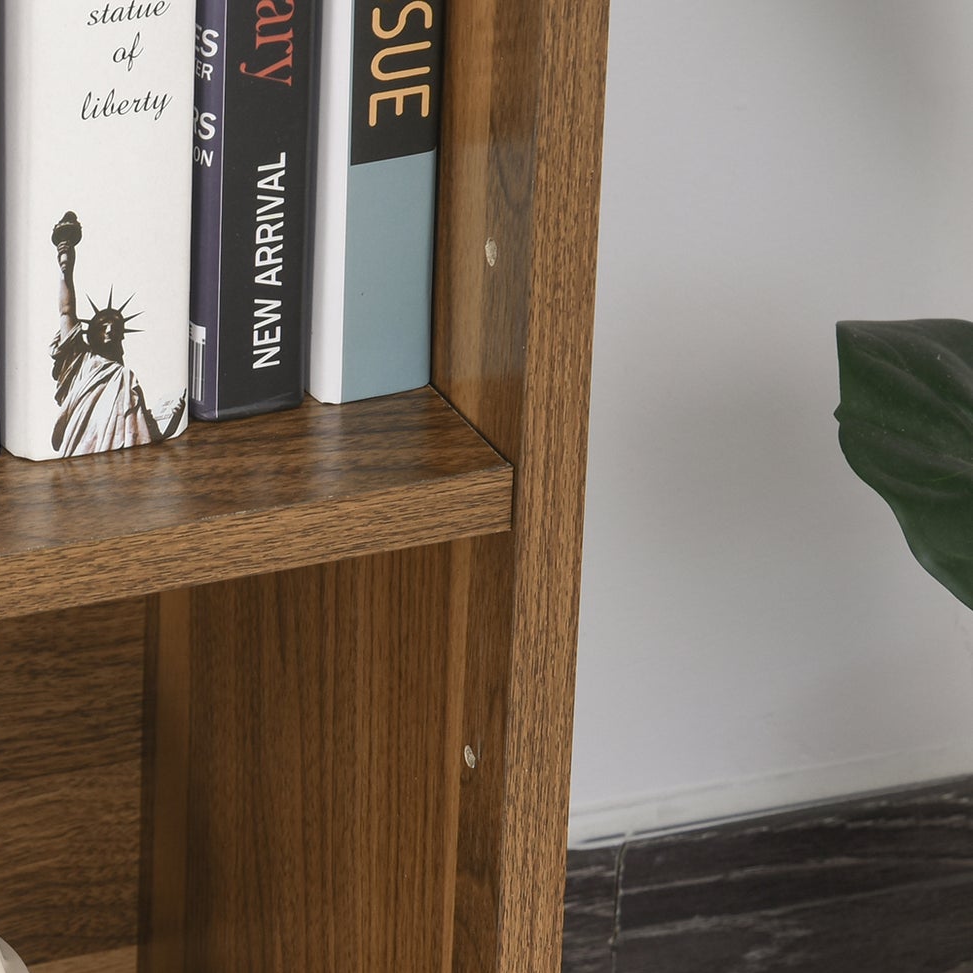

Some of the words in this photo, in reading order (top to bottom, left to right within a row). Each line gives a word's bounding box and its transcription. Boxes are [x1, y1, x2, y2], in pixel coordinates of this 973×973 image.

[87, 0, 171, 26] statue
[113, 31, 144, 72] of
[81, 88, 173, 121] liberty
[254, 151, 287, 286] ARRIVAL
[252, 299, 282, 369] NEW
